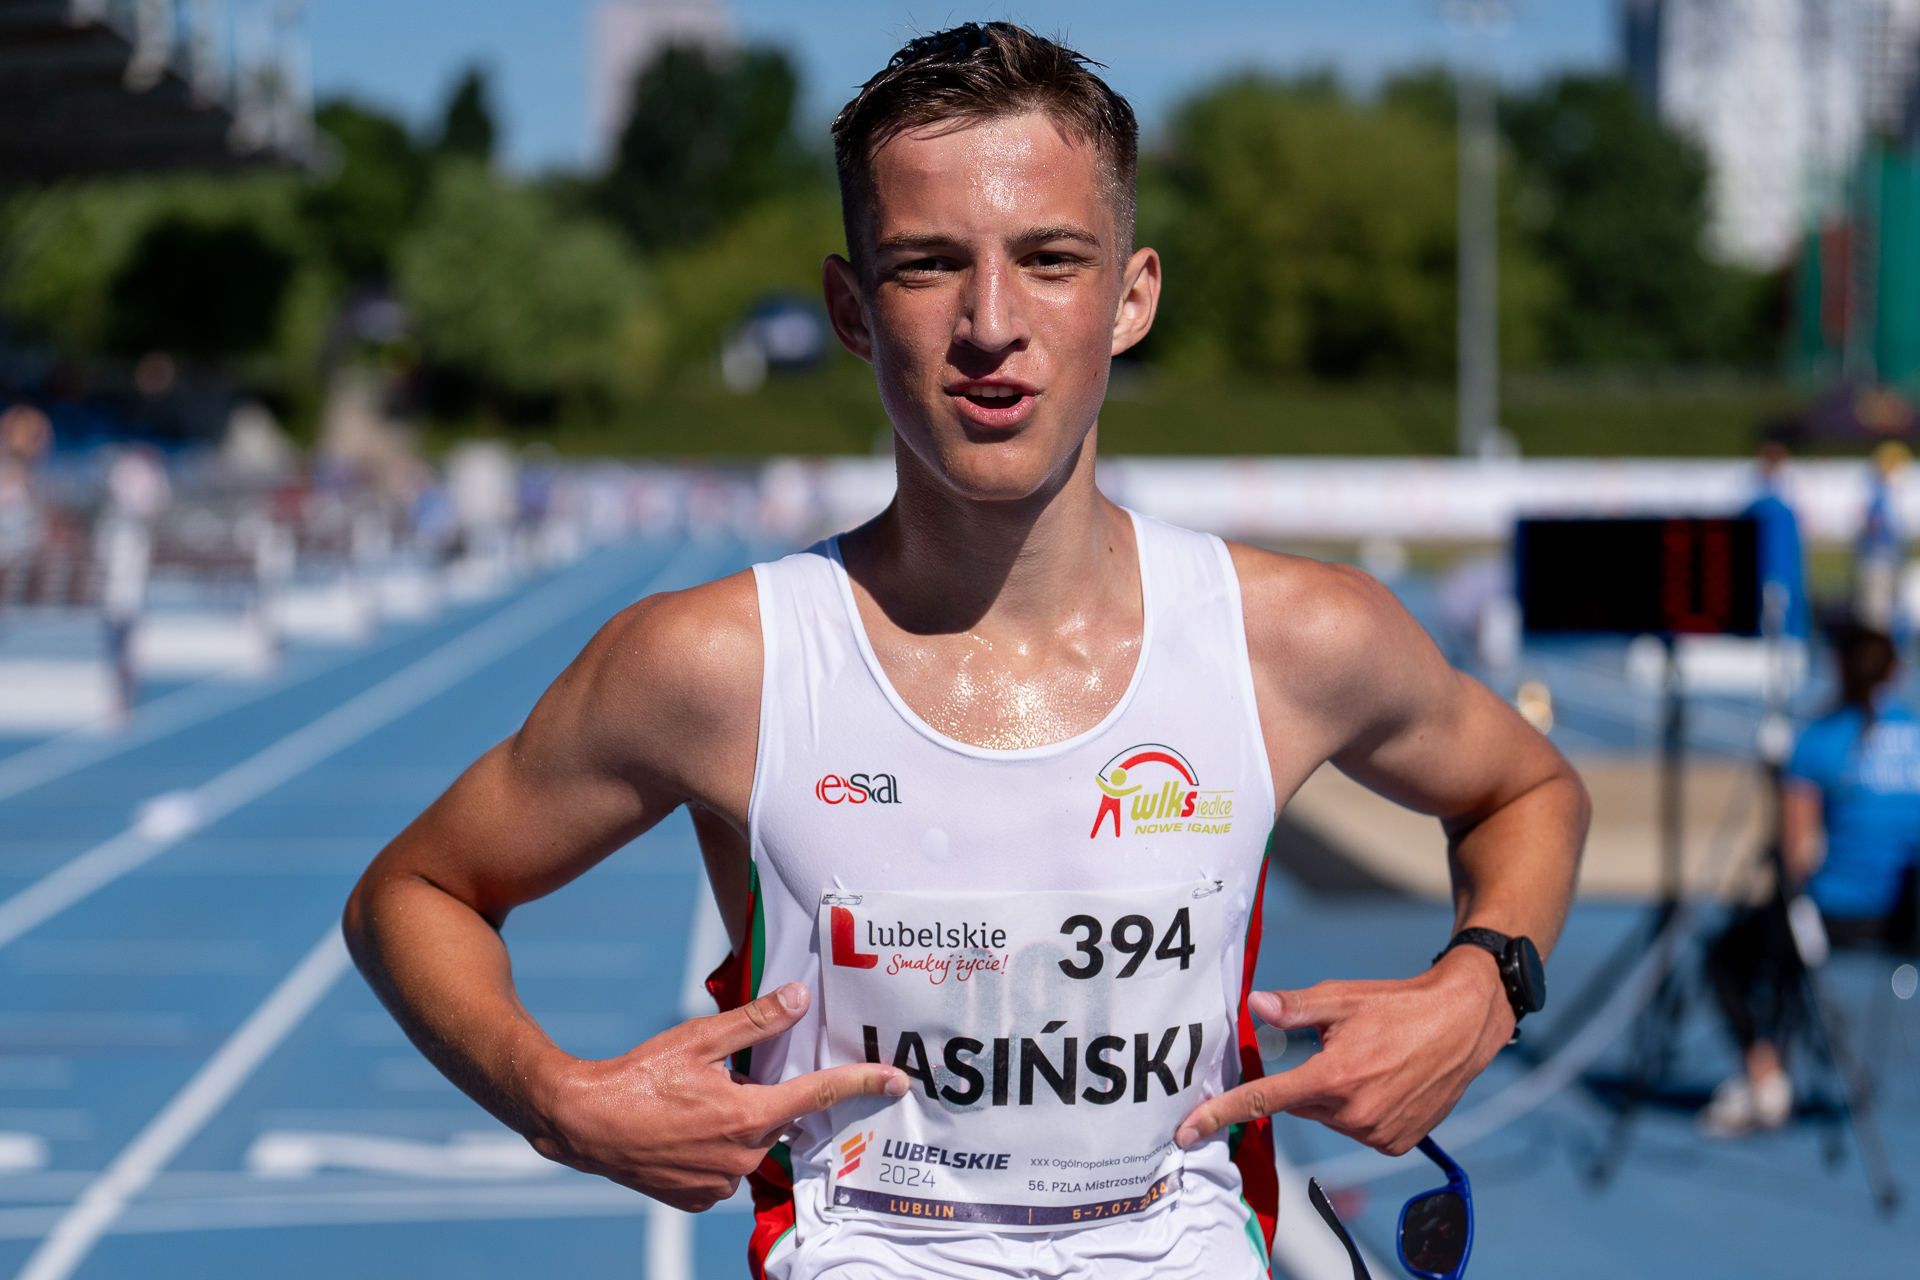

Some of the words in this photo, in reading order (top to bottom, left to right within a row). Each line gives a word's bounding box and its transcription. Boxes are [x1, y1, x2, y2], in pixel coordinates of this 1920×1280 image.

[1134, 822, 1184, 835] NOWE
[1186, 822, 1233, 835] IGANIE
[867, 920, 1007, 949] lubelskie
[1057, 906, 1196, 980] 394
[886, 953, 954, 985] Smakuj
[956, 954, 1010, 982] życie!
[882, 1139, 1012, 1170] LUBELSKIE
[1030, 1158, 1050, 1167] XXX
[1052, 1156, 1121, 1171] Ogólnopolska
[879, 1162, 936, 1188] 2024
[1028, 1180, 1048, 1192] 56.
[1052, 1181, 1082, 1193] PZLA
[890, 1199, 955, 1218] LUBLIN
